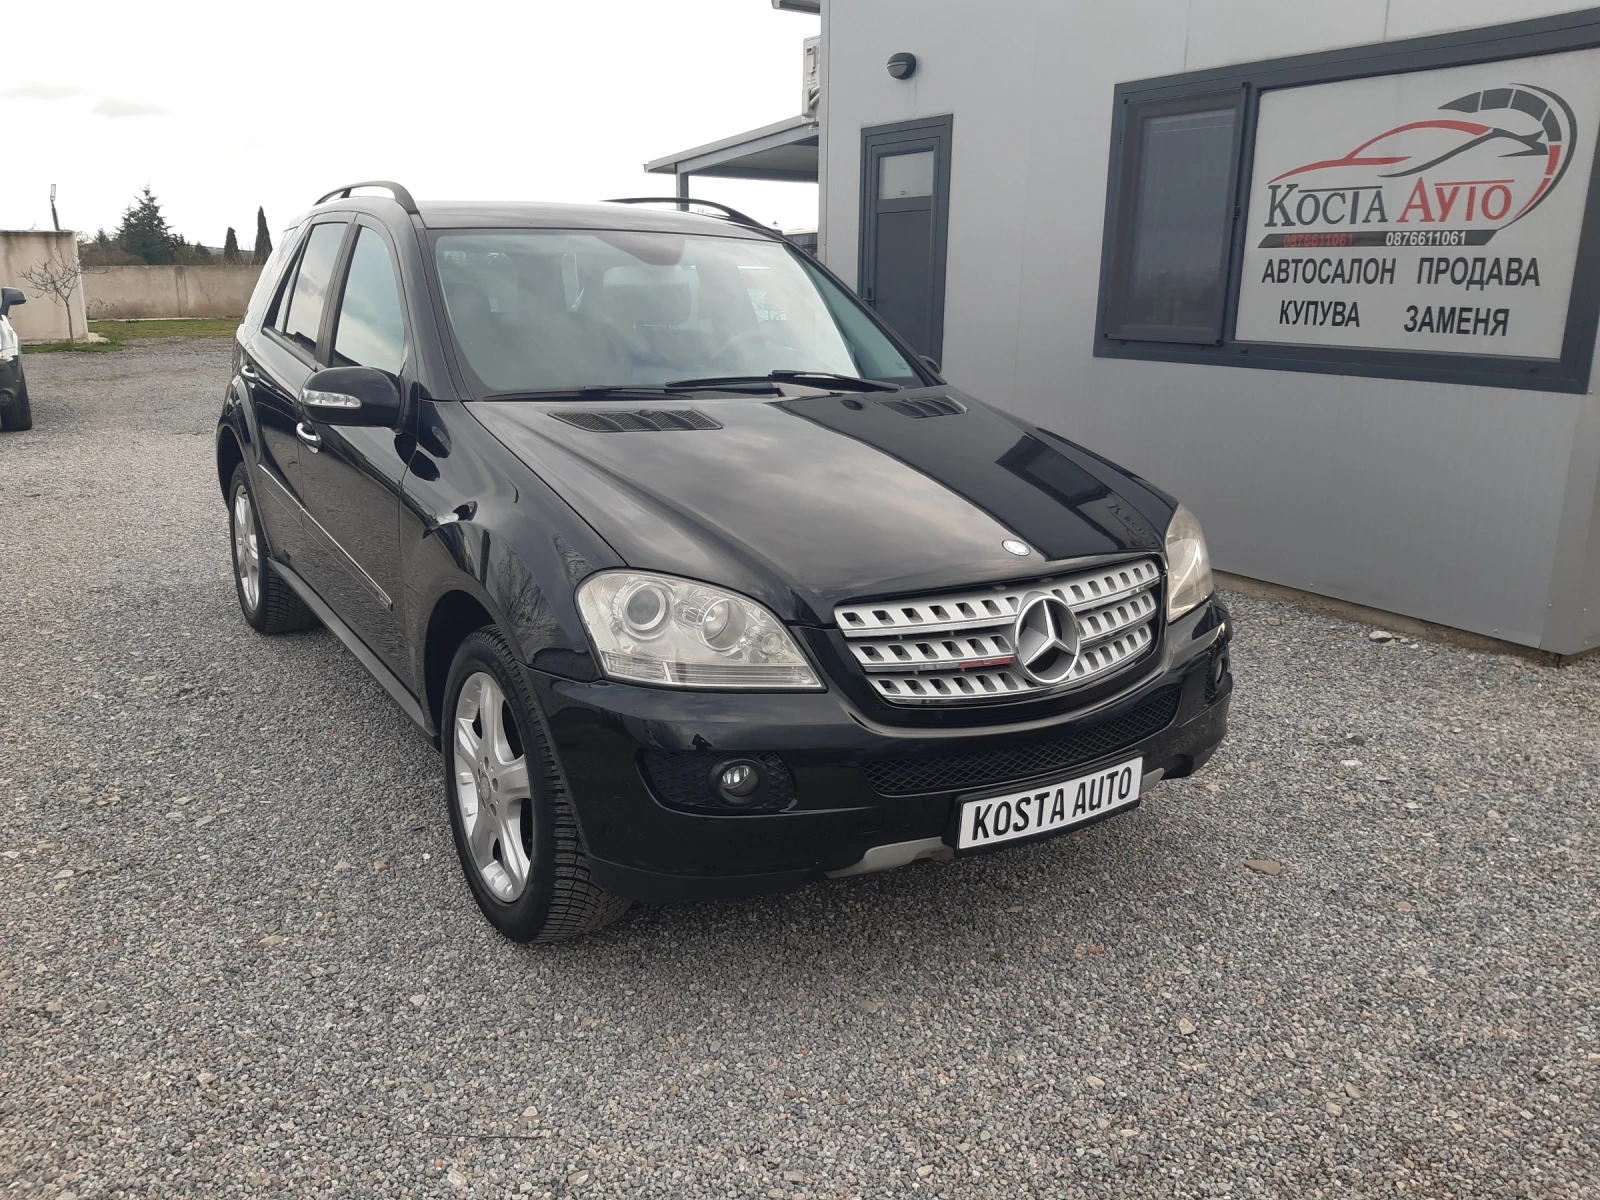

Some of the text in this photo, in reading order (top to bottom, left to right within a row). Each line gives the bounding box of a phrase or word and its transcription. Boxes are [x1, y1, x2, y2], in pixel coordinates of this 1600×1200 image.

[1283, 234, 1353, 248] 0876611061
[1385, 231, 1466, 246] 0876611061
[1262, 257, 1540, 291] АВТОСАЛОН ПРОДАВА
[1279, 300, 1510, 336] КУПУВА ЗАМЕНЯ
[971, 766, 1132, 841] KOSTA AUTO
